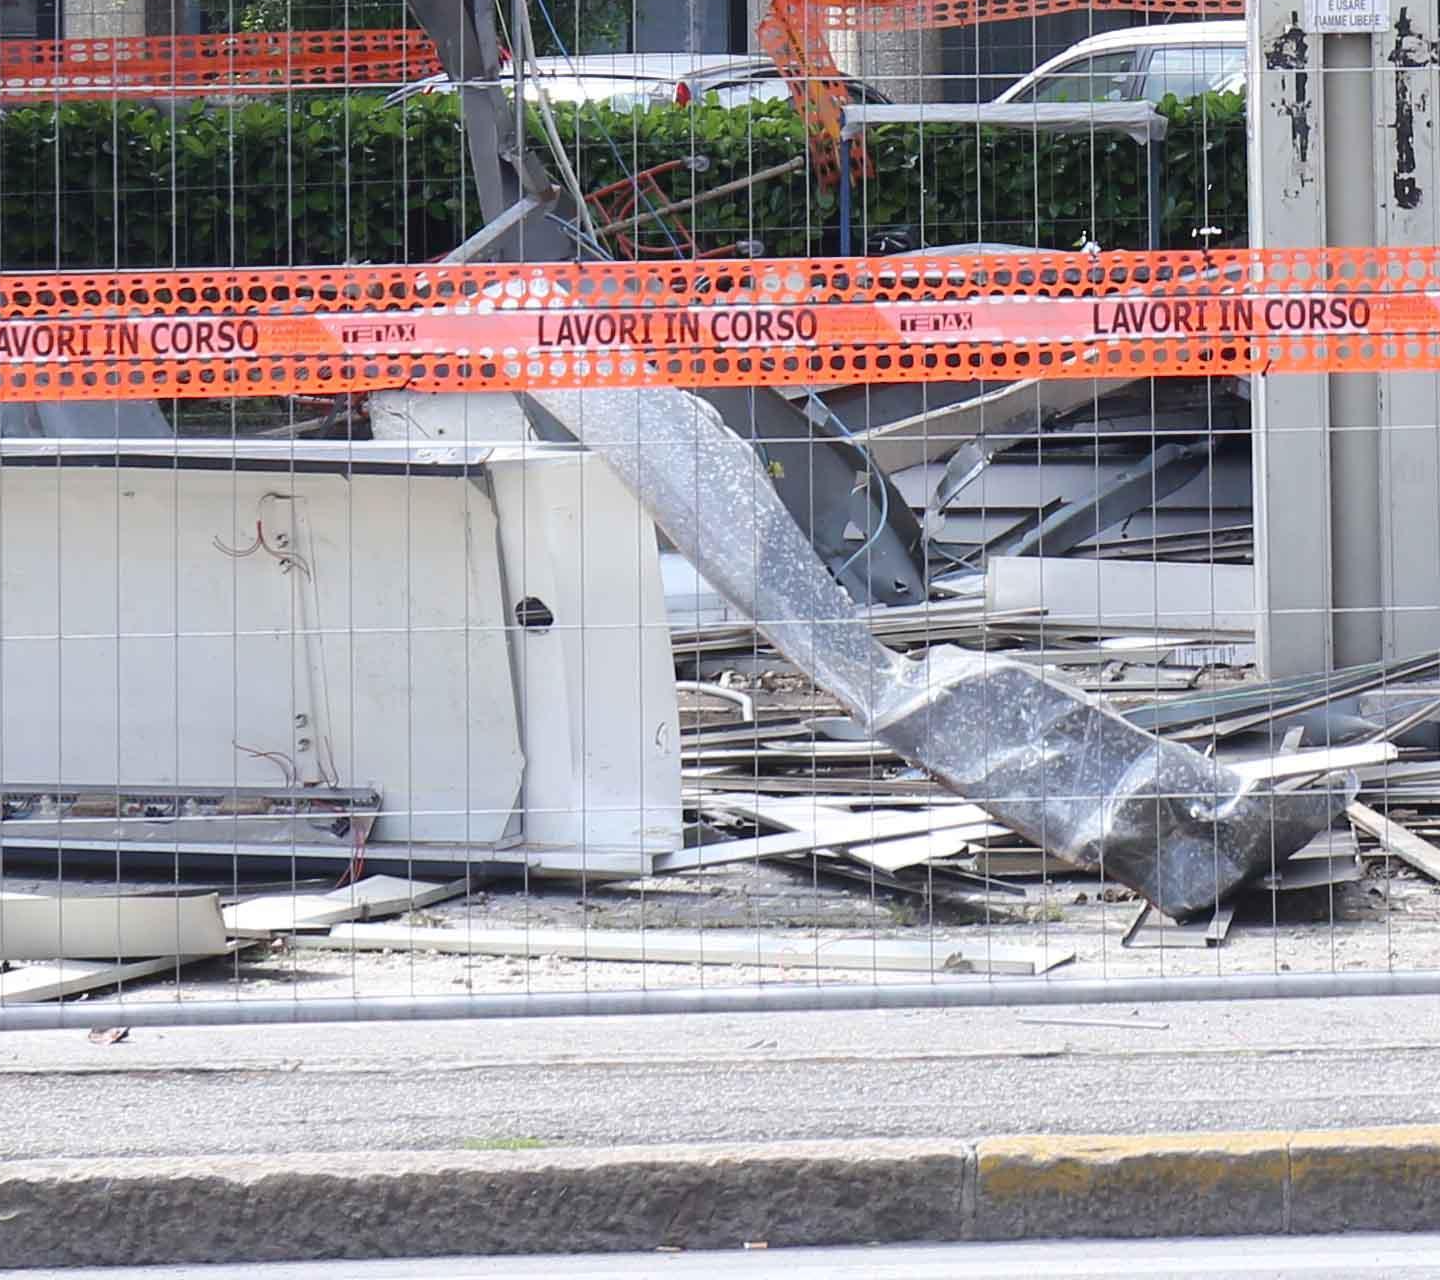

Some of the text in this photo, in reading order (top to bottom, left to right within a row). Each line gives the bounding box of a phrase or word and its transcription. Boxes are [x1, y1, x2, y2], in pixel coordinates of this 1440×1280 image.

[1328, 0, 1367, 11] E USARE
[538, 312, 654, 347] LAVORI
[665, 311, 700, 344] IN
[711, 309, 818, 342] CORSO
[901, 312, 972, 332] TENAX
[1093, 300, 1210, 334] LAVORI
[1219, 299, 1254, 331] IN
[1265, 297, 1371, 329] CORSO
[103, 322, 139, 356] IN
[149, 320, 258, 354] CORSO
[342, 323, 415, 343] TENAX
